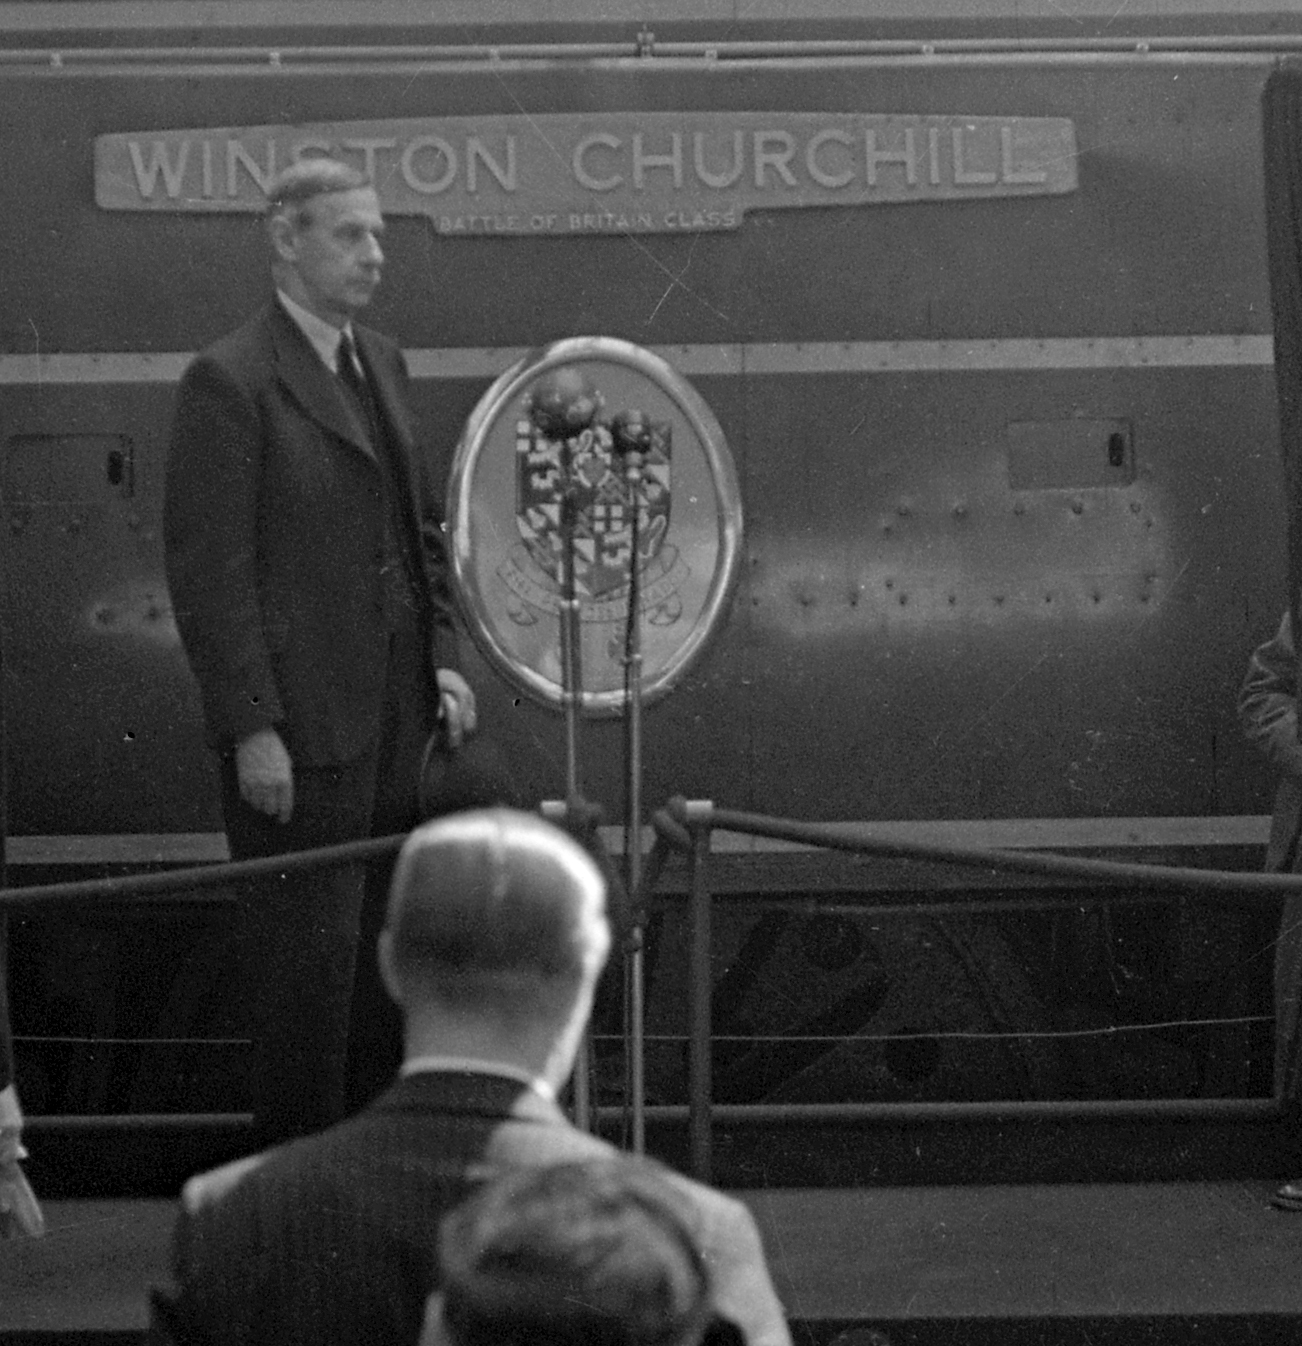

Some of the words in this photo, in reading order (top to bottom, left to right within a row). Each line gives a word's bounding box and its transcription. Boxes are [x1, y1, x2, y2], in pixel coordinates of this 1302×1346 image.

[571, 127, 1050, 191] CHURCHILL
[439, 214, 518, 232] BATTLE
[529, 213, 556, 230] OF
[569, 210, 652, 230] BRITAIN
[664, 208, 738, 228] CLASS
